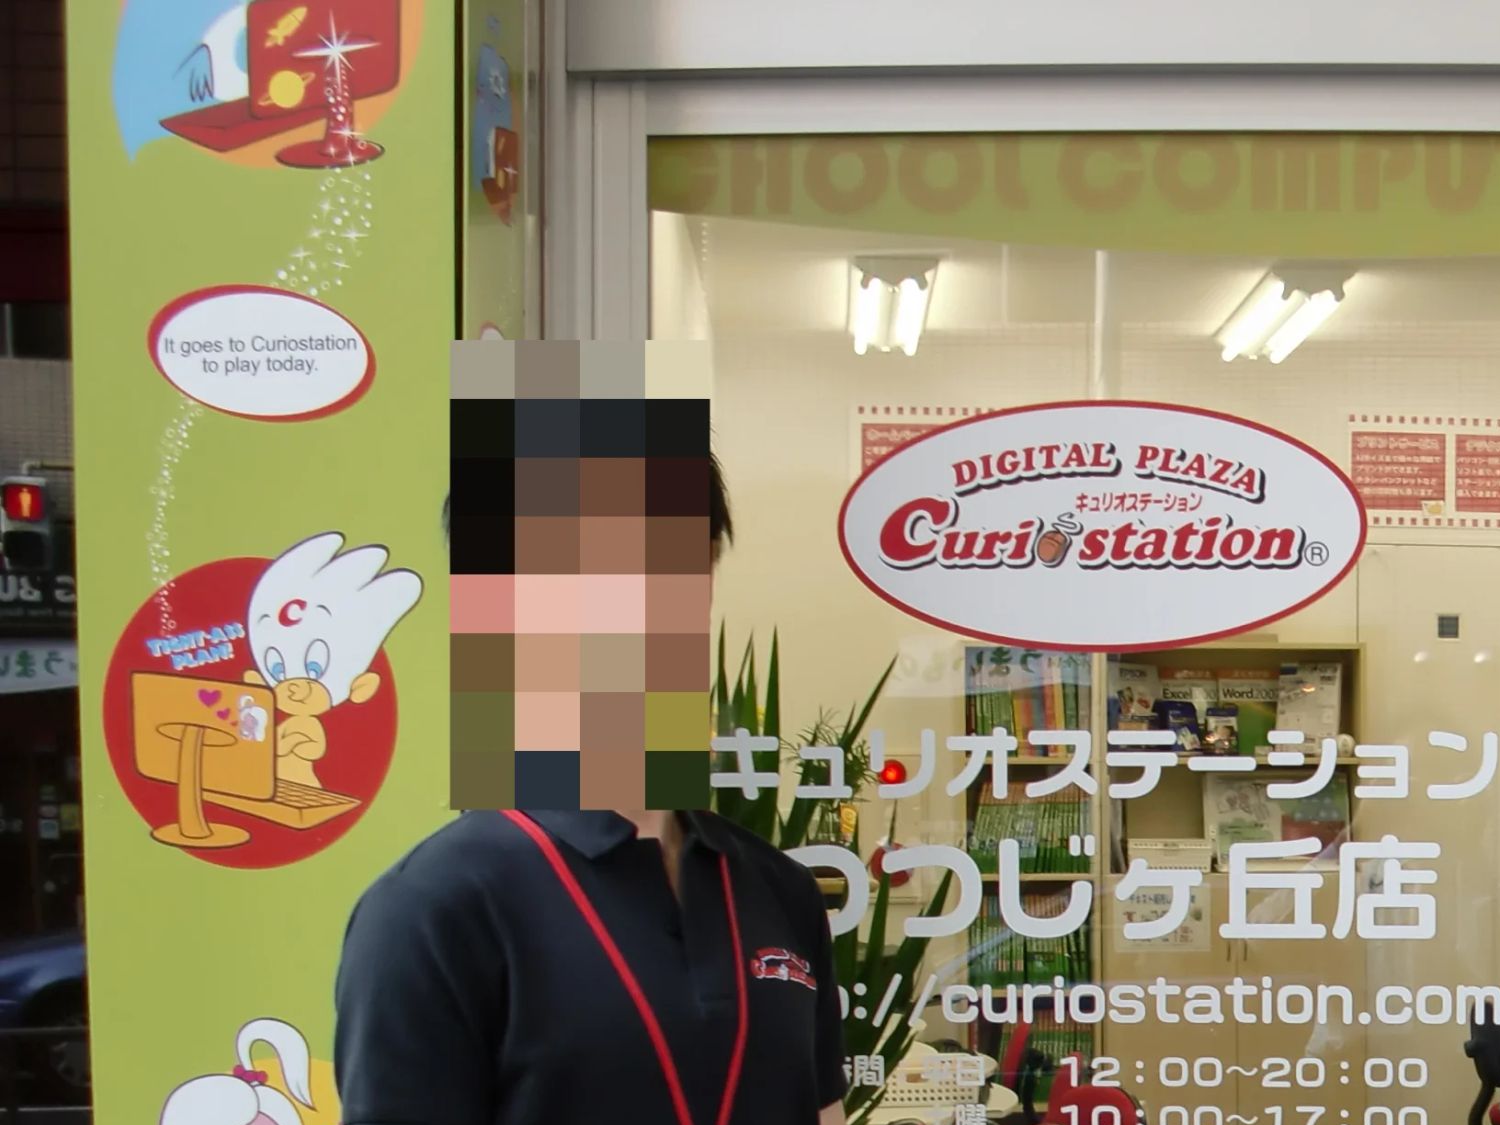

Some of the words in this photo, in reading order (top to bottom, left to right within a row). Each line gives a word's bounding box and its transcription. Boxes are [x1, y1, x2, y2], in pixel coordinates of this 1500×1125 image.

[163, 337, 175, 354] It
[180, 340, 223, 358] goes
[229, 337, 246, 353] to
[251, 334, 357, 354] Curiostation
[202, 356, 219, 373] to
[225, 356, 261, 376] play
[266, 355, 319, 376] today.
[951, 442, 1117, 492] DIGITAL
[1135, 444, 1265, 500] PLAZA
[1075, 491, 1203, 513] キュリオステーション
[1222, 687, 1255, 700] Word
[710, 727, 1498, 801] キュリオステーション
